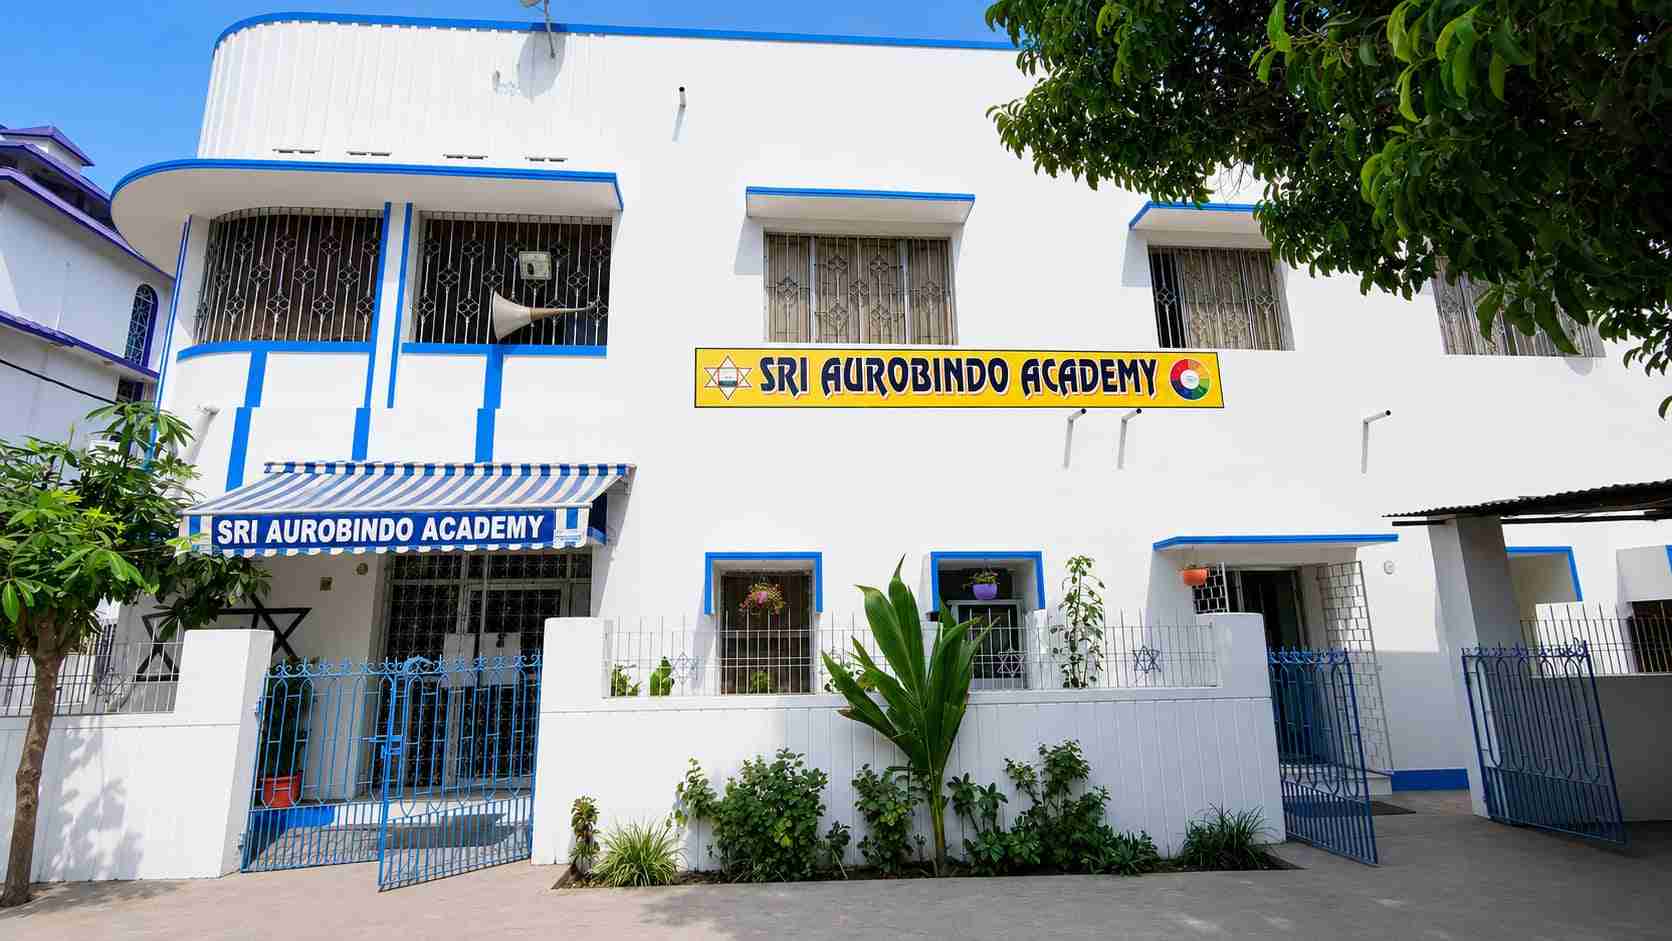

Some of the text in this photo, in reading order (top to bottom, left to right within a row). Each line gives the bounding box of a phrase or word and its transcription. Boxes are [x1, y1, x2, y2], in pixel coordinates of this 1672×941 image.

[759, 356, 1158, 398] SRI AUROBINDO ACADEMY
[217, 519, 258, 545] SRI
[265, 517, 414, 544] AUROBINDO
[421, 514, 545, 541] ACADEMY
